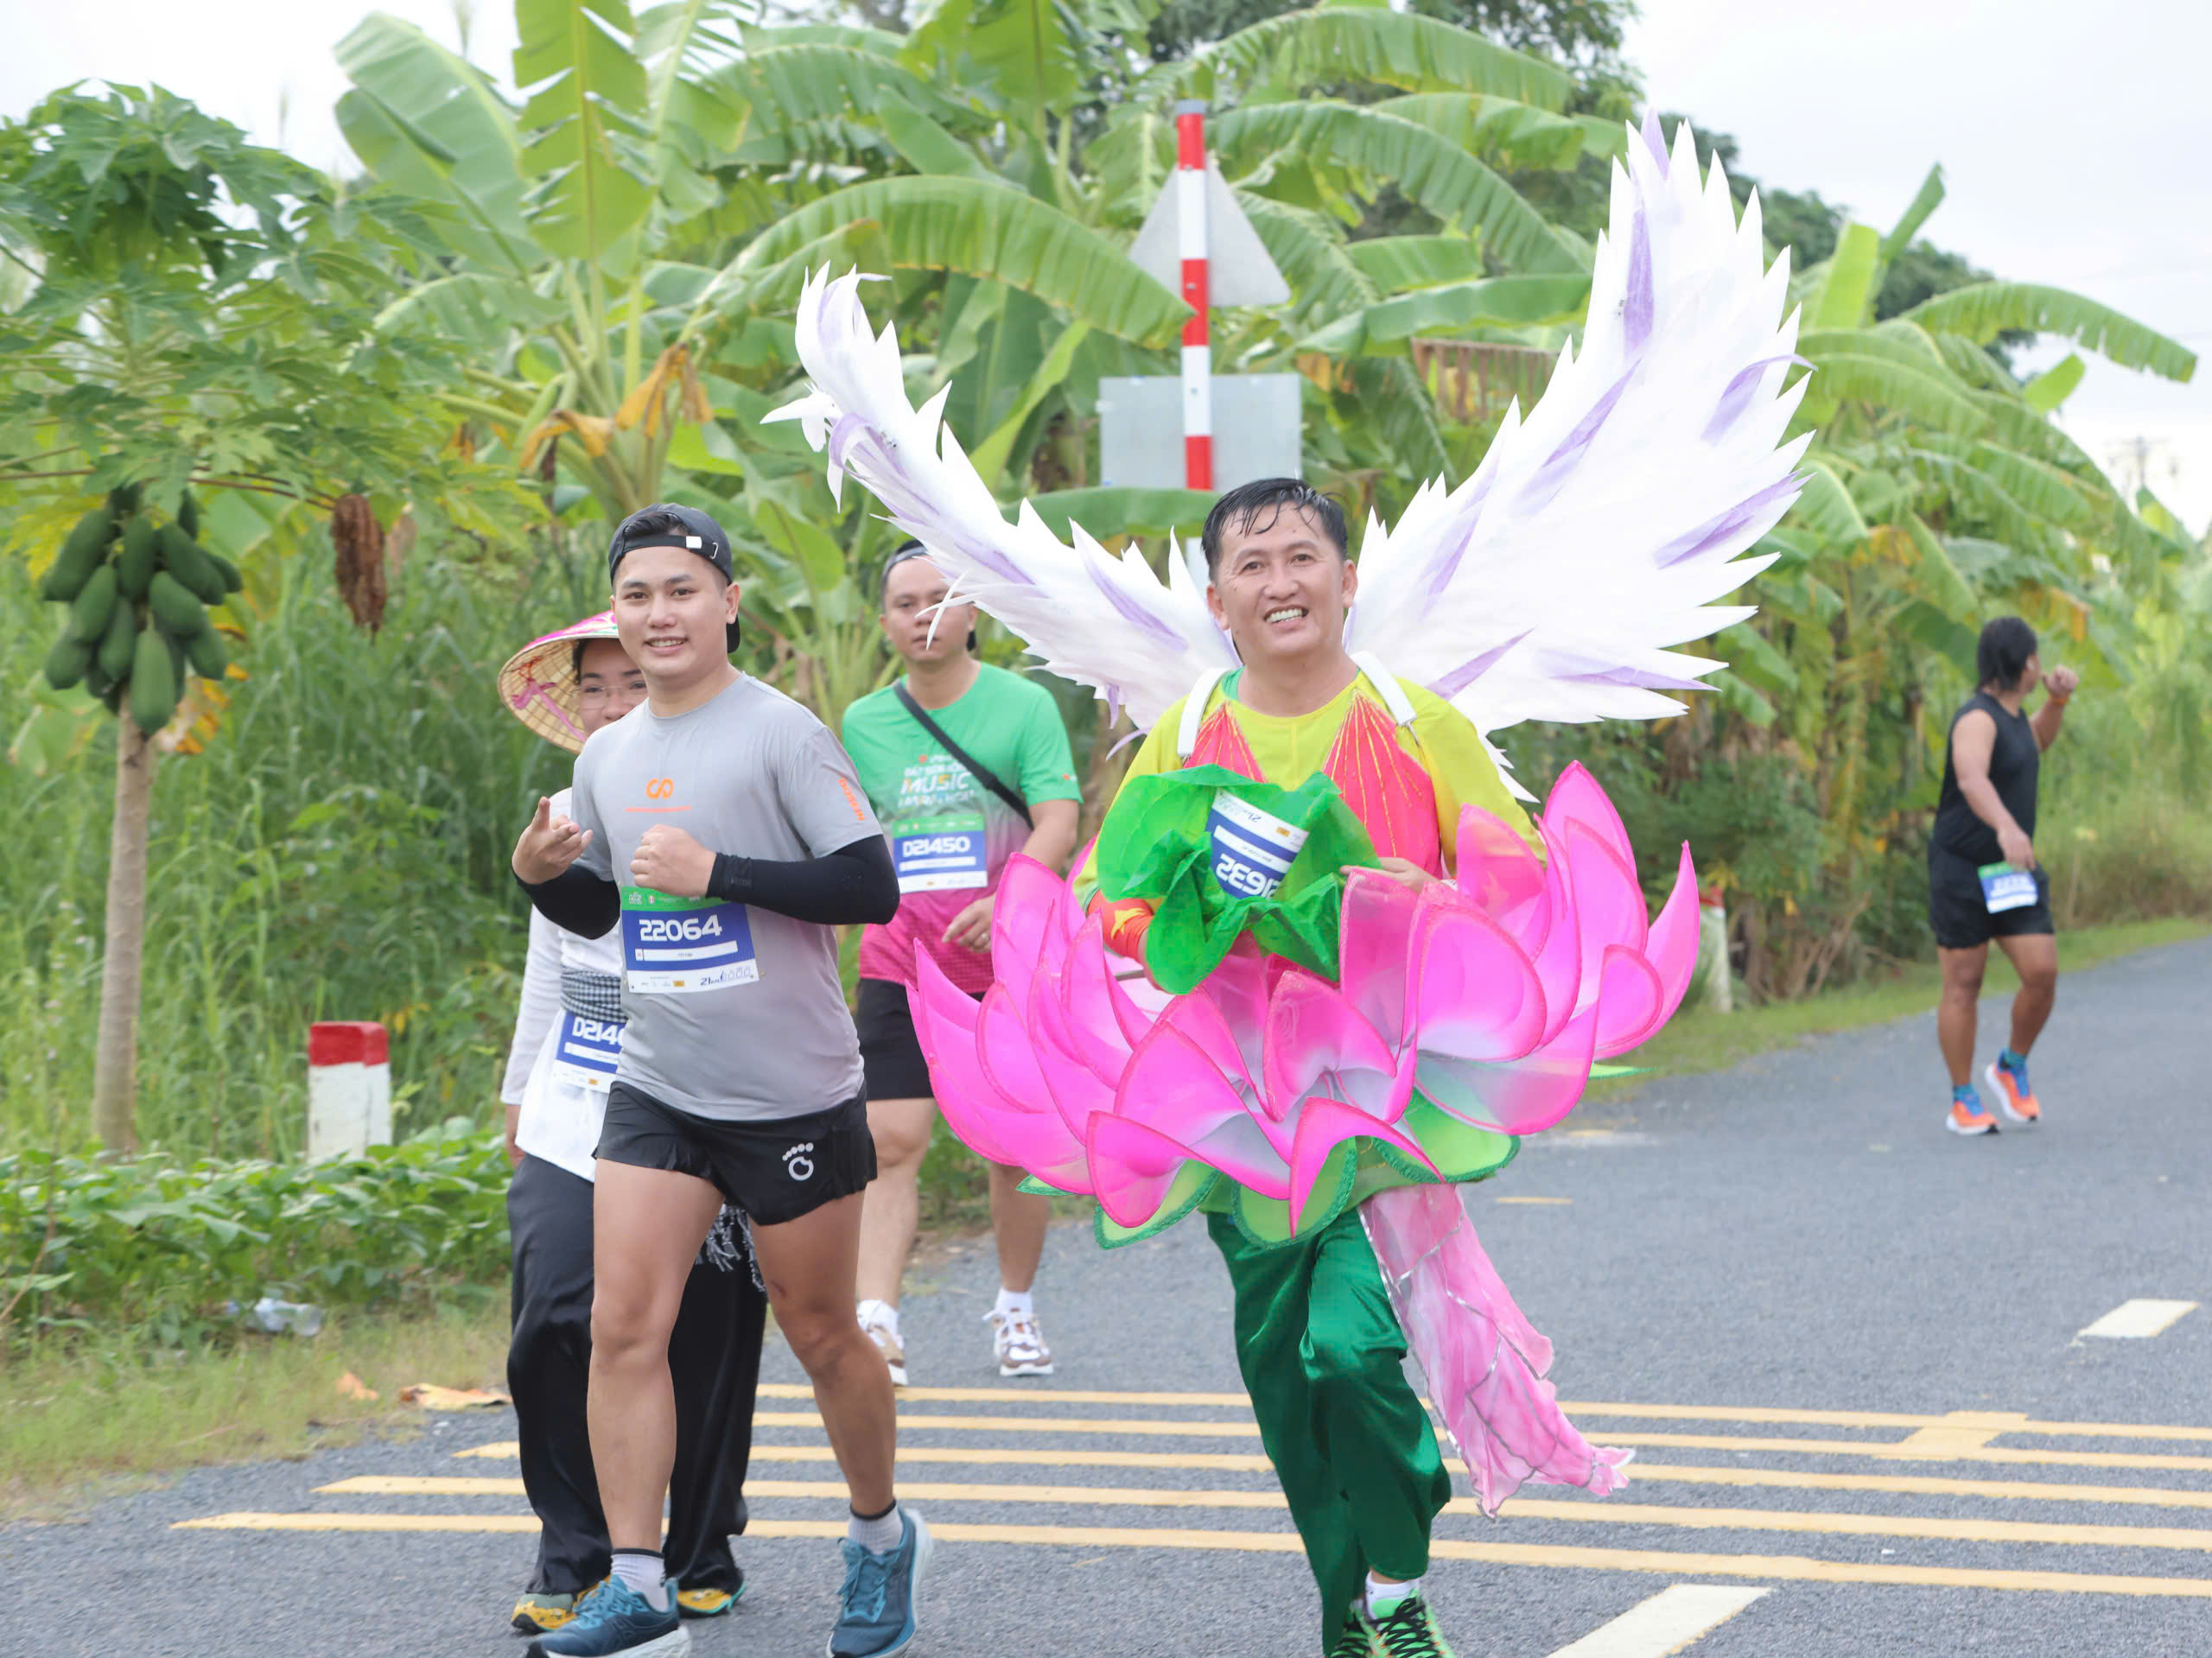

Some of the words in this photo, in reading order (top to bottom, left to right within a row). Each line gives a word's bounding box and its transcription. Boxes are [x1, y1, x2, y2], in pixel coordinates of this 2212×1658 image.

[900, 771, 974, 795] MUSIC
[902, 835, 971, 858] D21450
[639, 913, 723, 942] 22064
